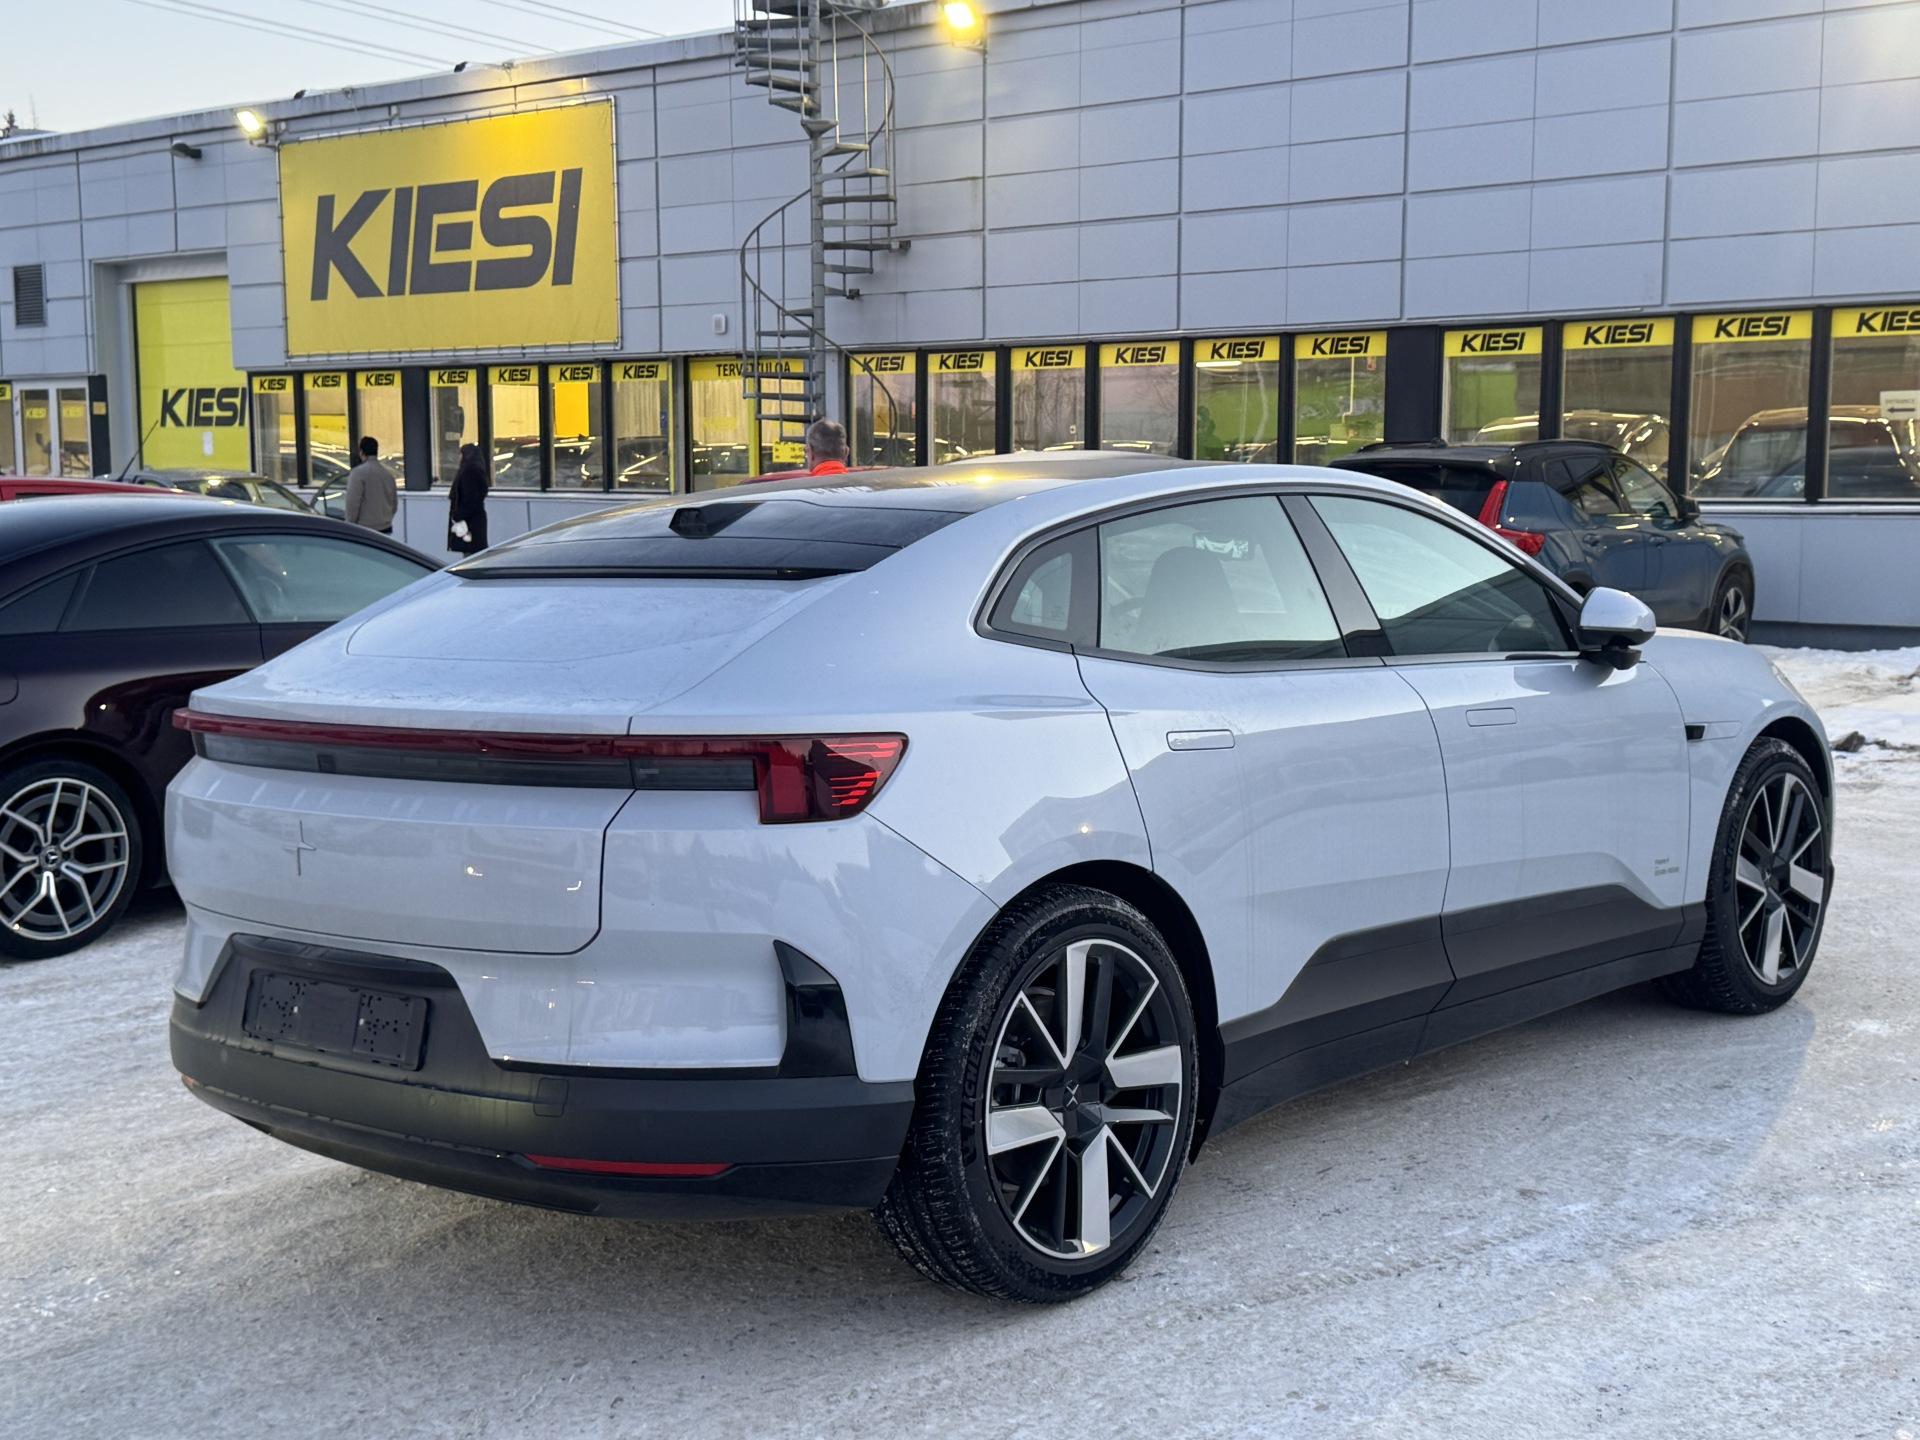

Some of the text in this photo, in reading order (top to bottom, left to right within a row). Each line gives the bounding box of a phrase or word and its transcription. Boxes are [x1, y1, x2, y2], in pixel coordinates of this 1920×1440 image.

[310, 168, 582, 301] KIESI
[1583, 323, 1654, 345] KIESI
[1714, 315, 1791, 339] KIESI
[1210, 341, 1265, 360] KIESI
[1312, 335, 1370, 355] KIESI
[1460, 332, 1526, 352] KIESI
[861, 355, 905, 372] KIESI
[938, 353, 984, 370] KIESI
[1024, 350, 1073, 367] KIESI
[1115, 346, 1166, 364] KIESI
[365, 372, 395, 386] KIESI
[437, 370, 469, 384] KIESI
[498, 367, 531, 382] KIESI
[559, 366, 593, 381] KIESI
[623, 364, 659, 379] KIESI
[259, 378, 287, 390] KIESI
[312, 374, 342, 388] KIESI
[160, 387, 247, 427] KIESI
